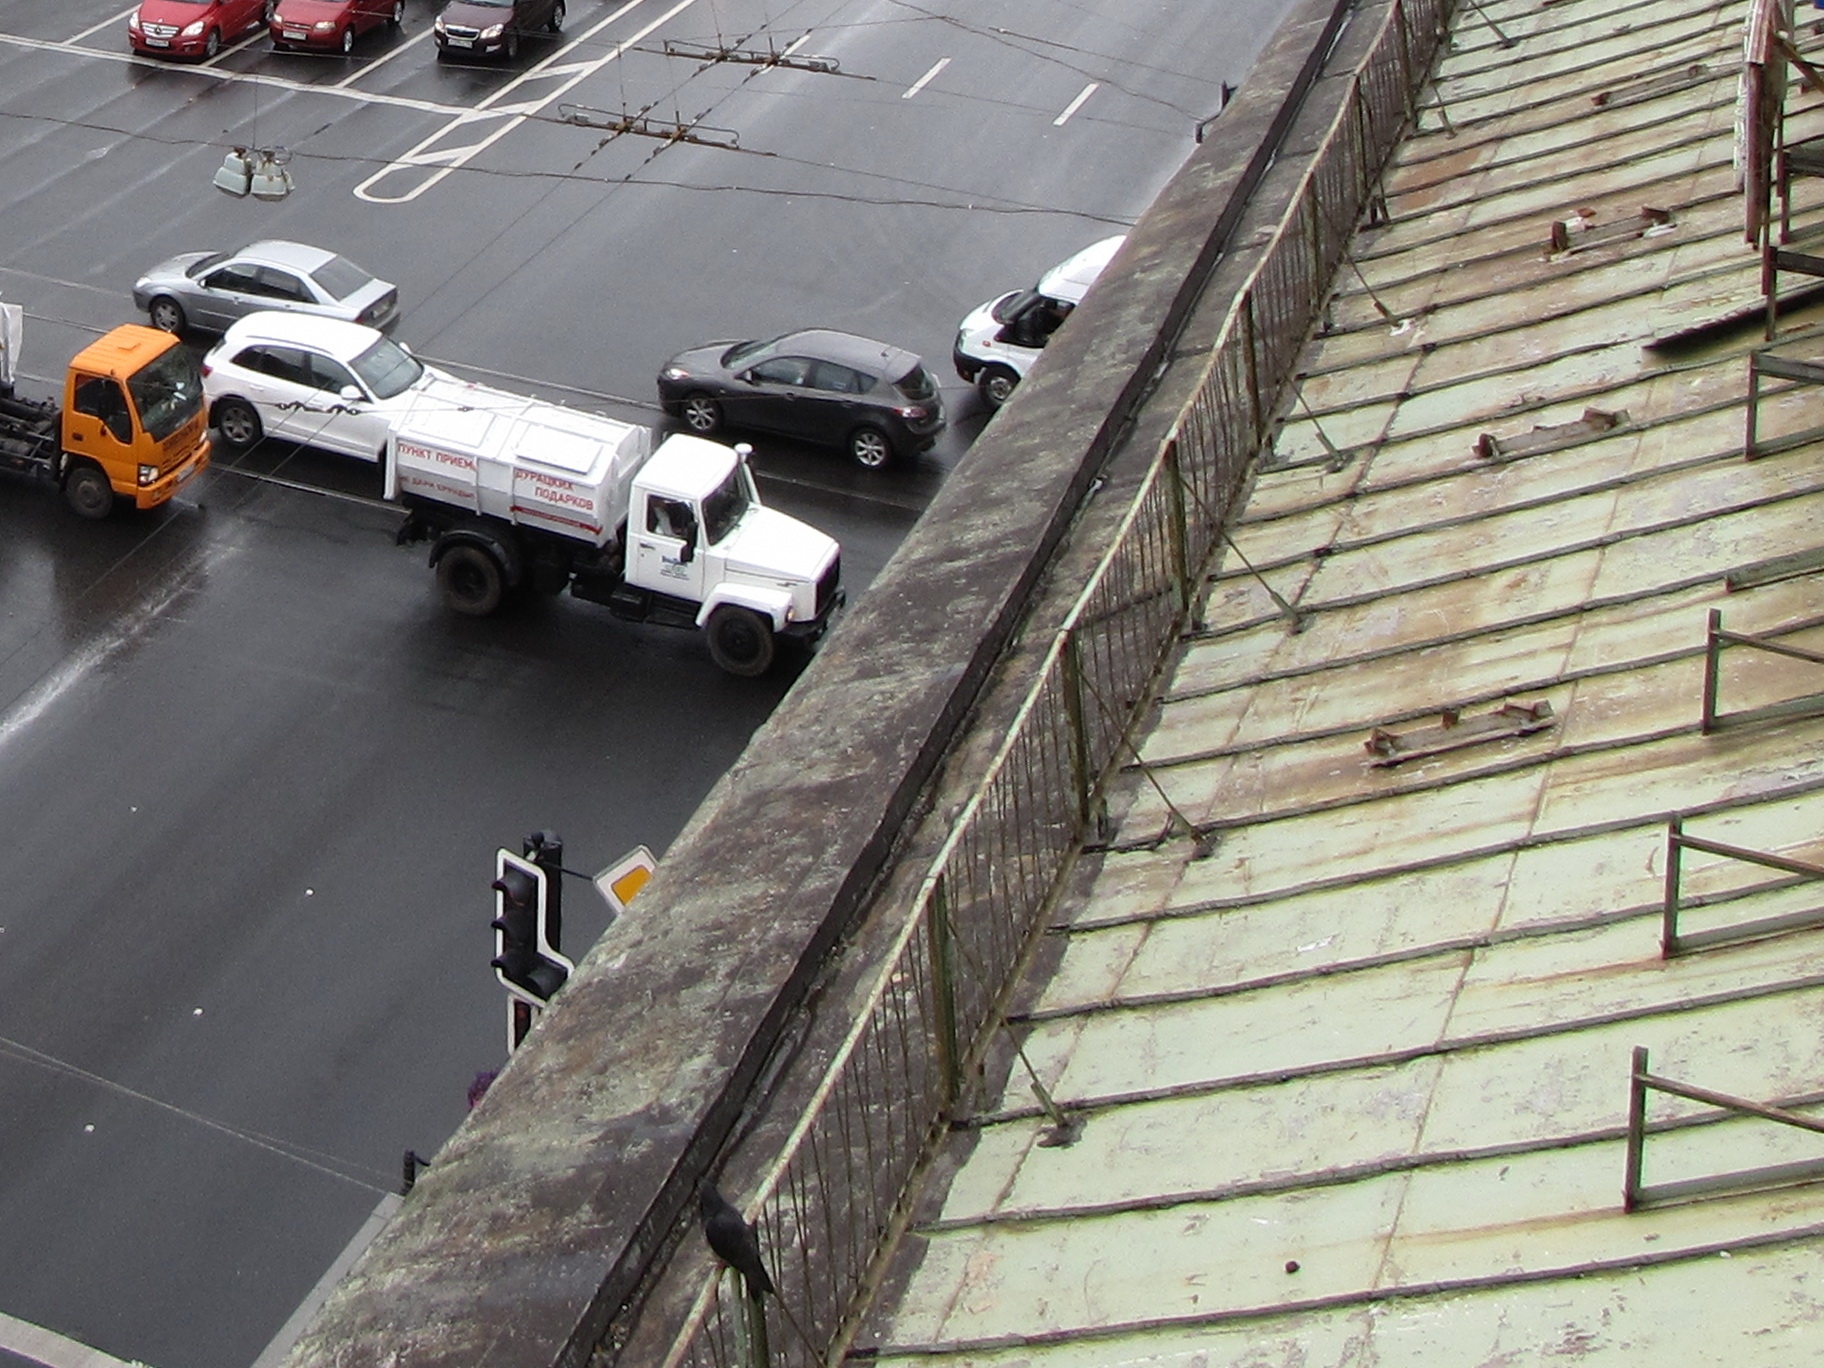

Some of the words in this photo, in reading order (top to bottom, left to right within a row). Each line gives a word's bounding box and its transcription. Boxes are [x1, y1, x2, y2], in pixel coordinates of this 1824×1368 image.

[398, 443, 432, 460] ПУНКТ
[514, 468, 574, 491] ДУРАЦКИХ
[535, 486, 594, 511] ПОДАРКОВ
